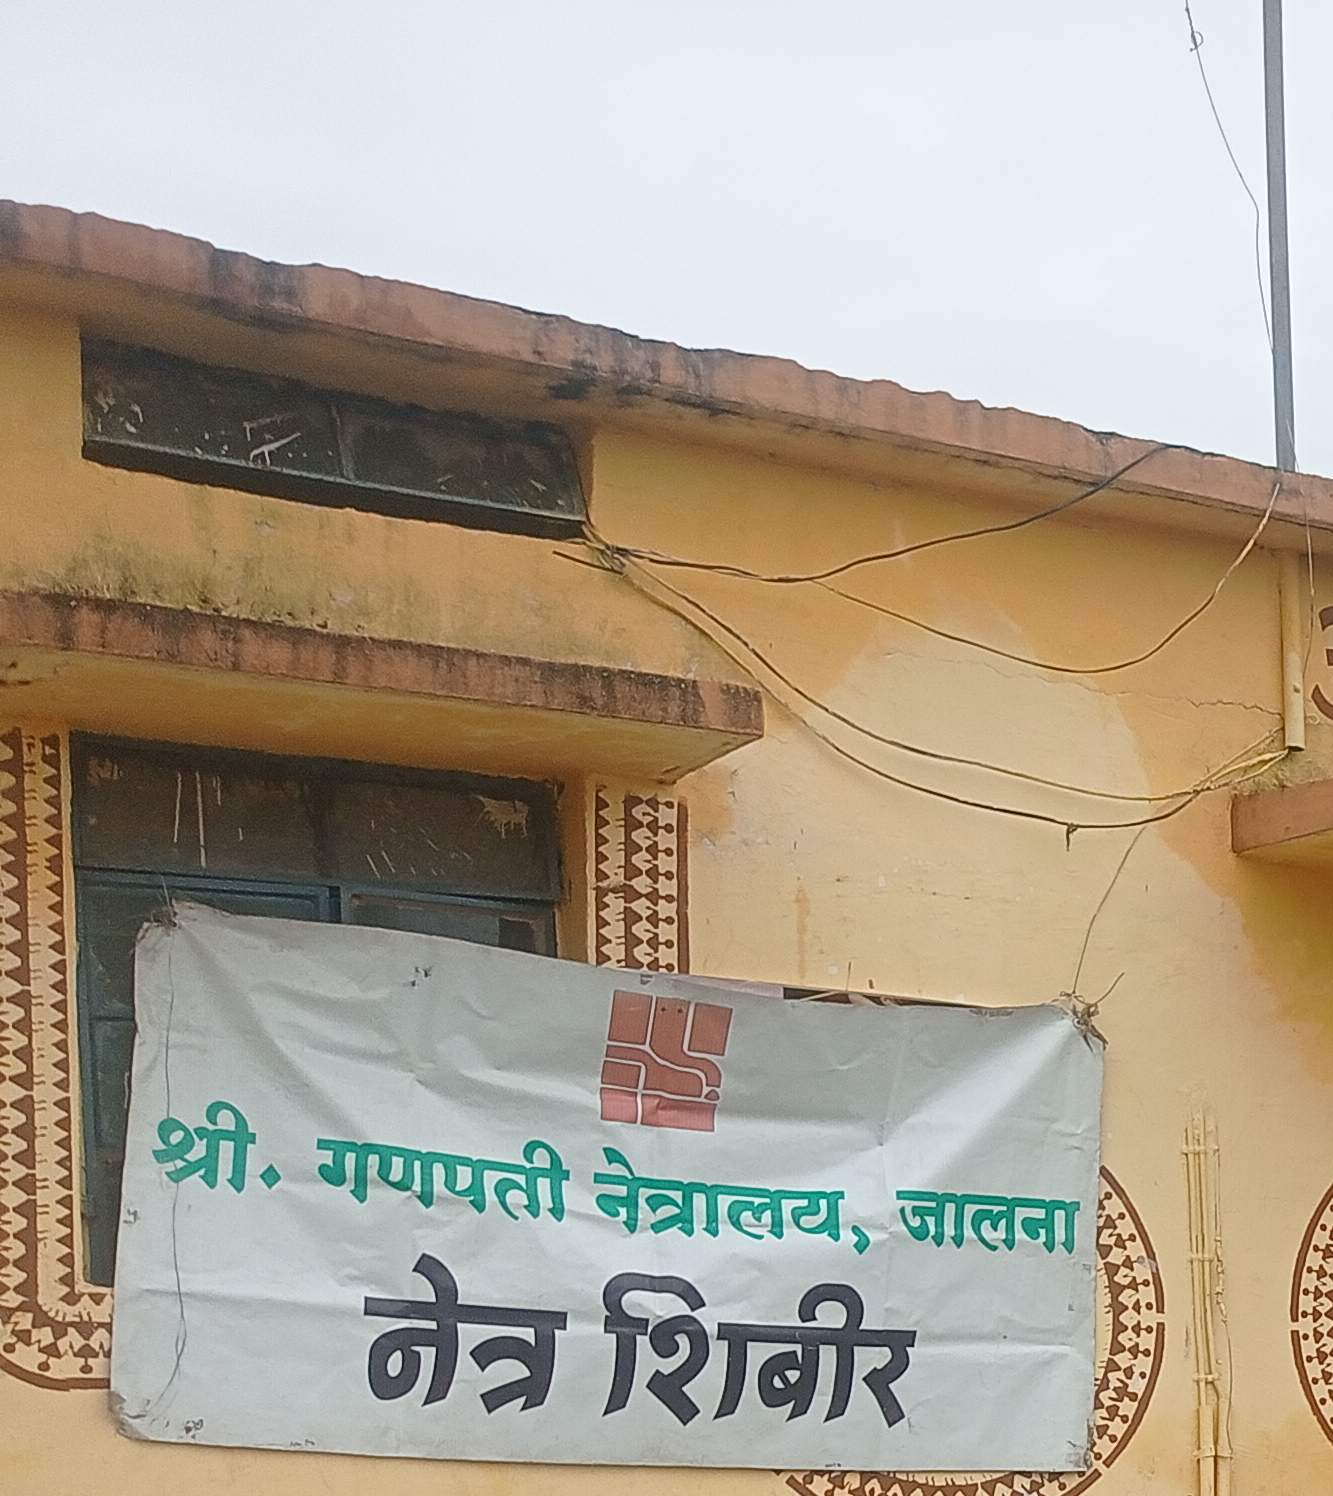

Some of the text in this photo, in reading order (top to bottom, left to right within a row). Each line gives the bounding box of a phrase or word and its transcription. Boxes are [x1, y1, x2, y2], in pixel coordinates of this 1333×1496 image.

[154, 1100, 1082, 1255] श्री. गणपती नेत्रालय, जालना
[363, 1254, 917, 1429] नेत्र शिबीर
